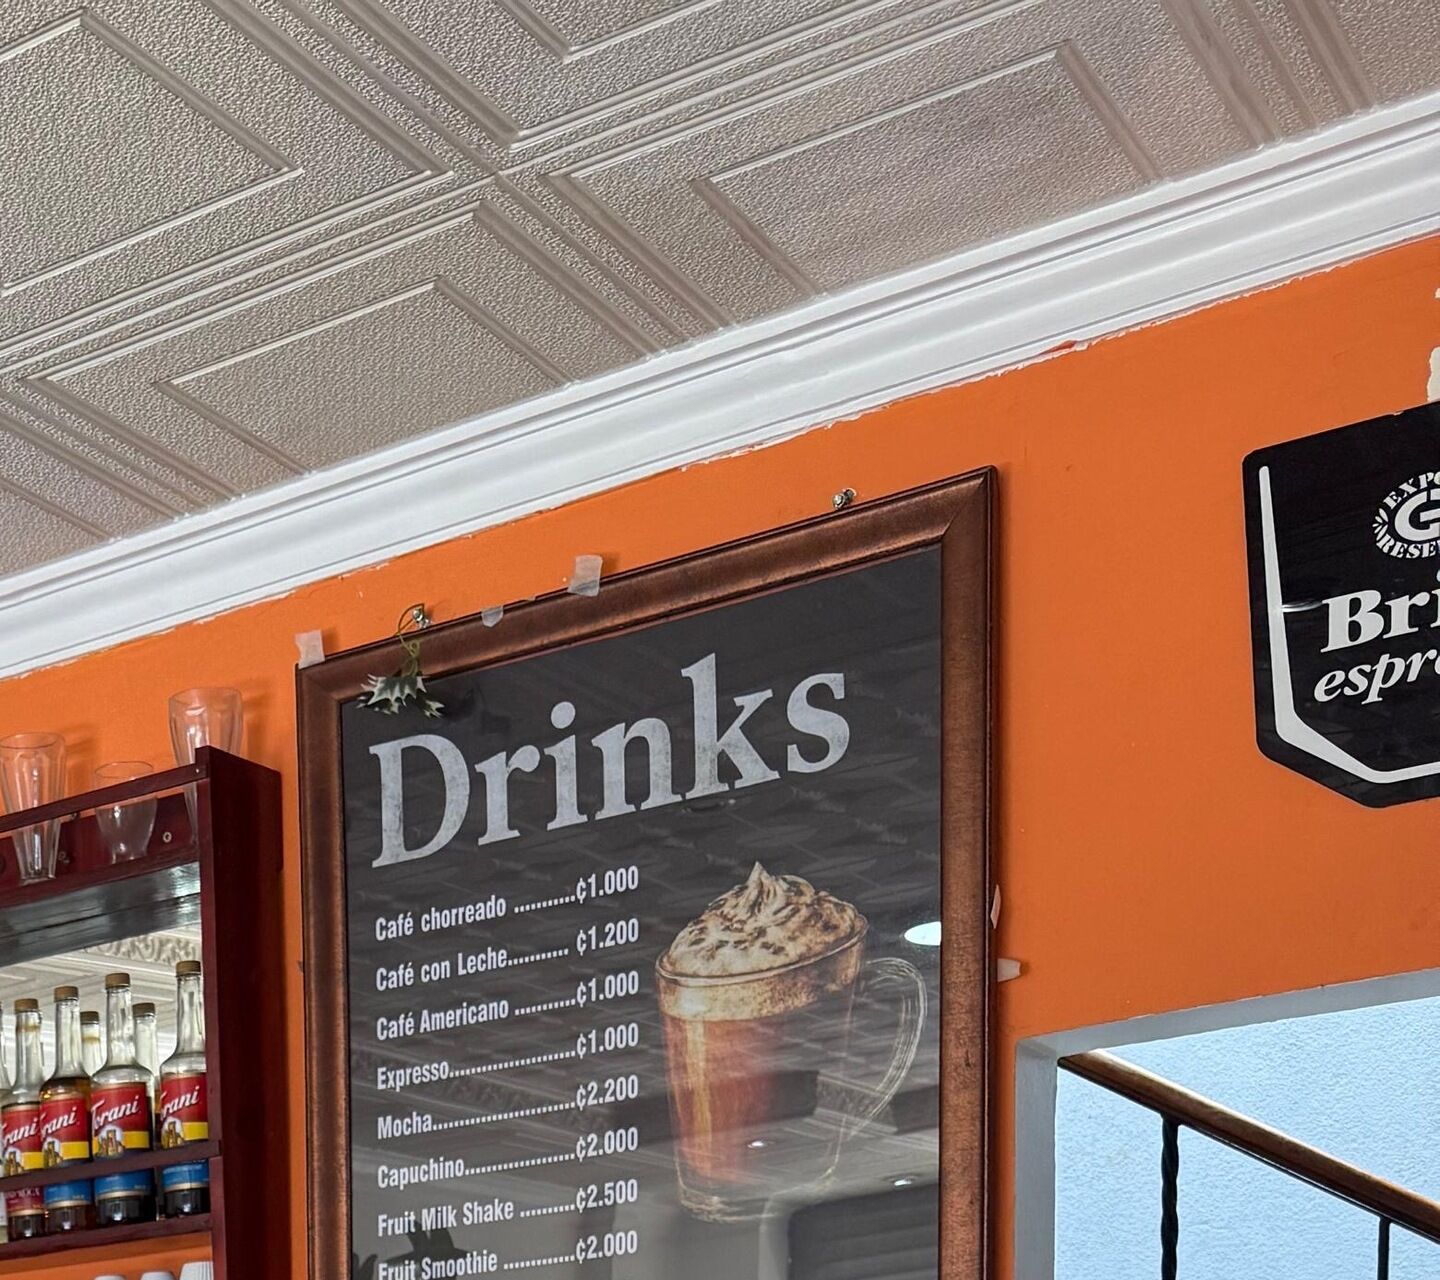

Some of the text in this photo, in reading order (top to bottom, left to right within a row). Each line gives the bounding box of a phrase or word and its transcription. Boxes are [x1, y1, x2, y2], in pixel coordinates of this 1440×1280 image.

[368, 652, 851, 869] Drinks
[376, 915, 413, 941] Café
[421, 894, 506, 932] chorreado
[376, 964, 414, 991] Café
[421, 960, 450, 983] con
[458, 947, 507, 976] Leche
[376, 1012, 415, 1040] Café
[420, 1000, 509, 1033] Americano
[377, 1061, 449, 1092] Expresso
[91, 1095, 139, 1130] Torani
[160, 1085, 199, 1120] rani
[2, 1118, 38, 1147] rani
[40, 1107, 76, 1141] rani
[377, 1111, 432, 1140] Mocha
[378, 1156, 464, 1190] Capuchino
[378, 1212, 416, 1237] Fruit
[422, 1205, 457, 1232] Milk
[463, 1199, 514, 1225] Shake
